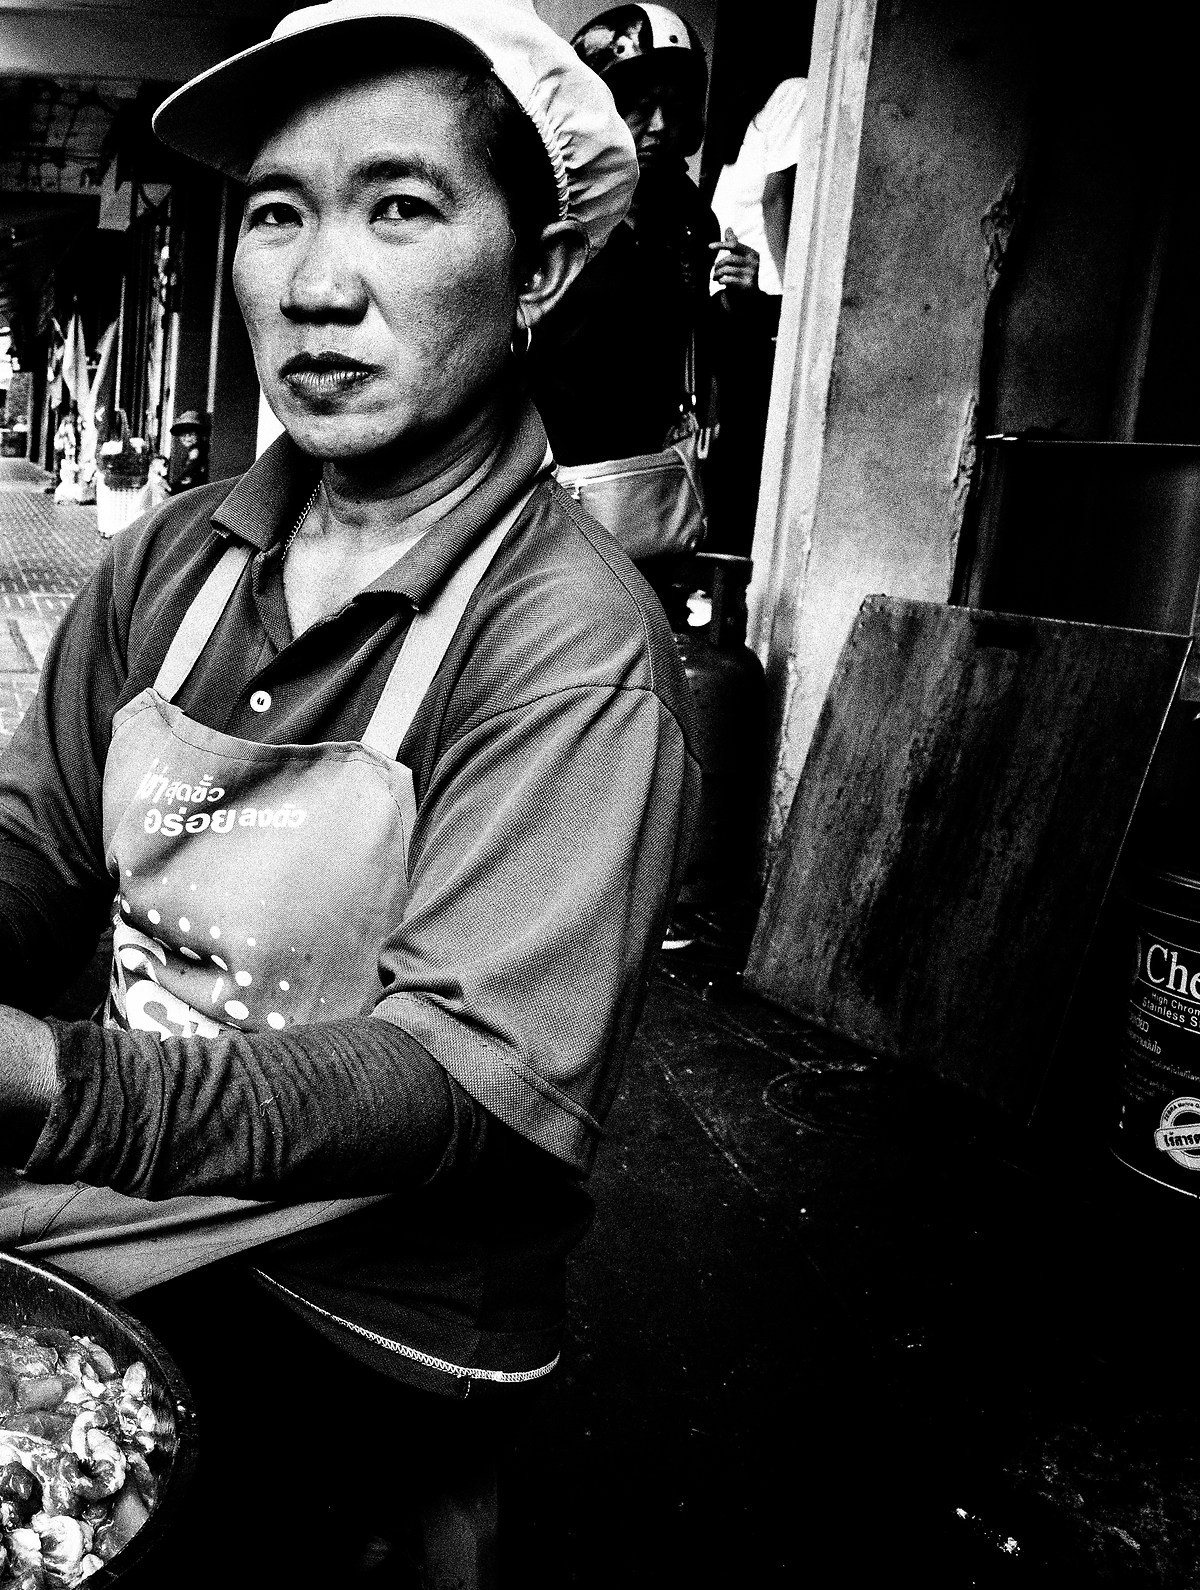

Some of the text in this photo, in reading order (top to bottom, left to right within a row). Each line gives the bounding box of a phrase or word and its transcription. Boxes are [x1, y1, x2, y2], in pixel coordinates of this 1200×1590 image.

[1151, 992, 1169, 1006] High
[1142, 996, 1186, 1024] Stainless
[1189, 1015, 1200, 1028] S
